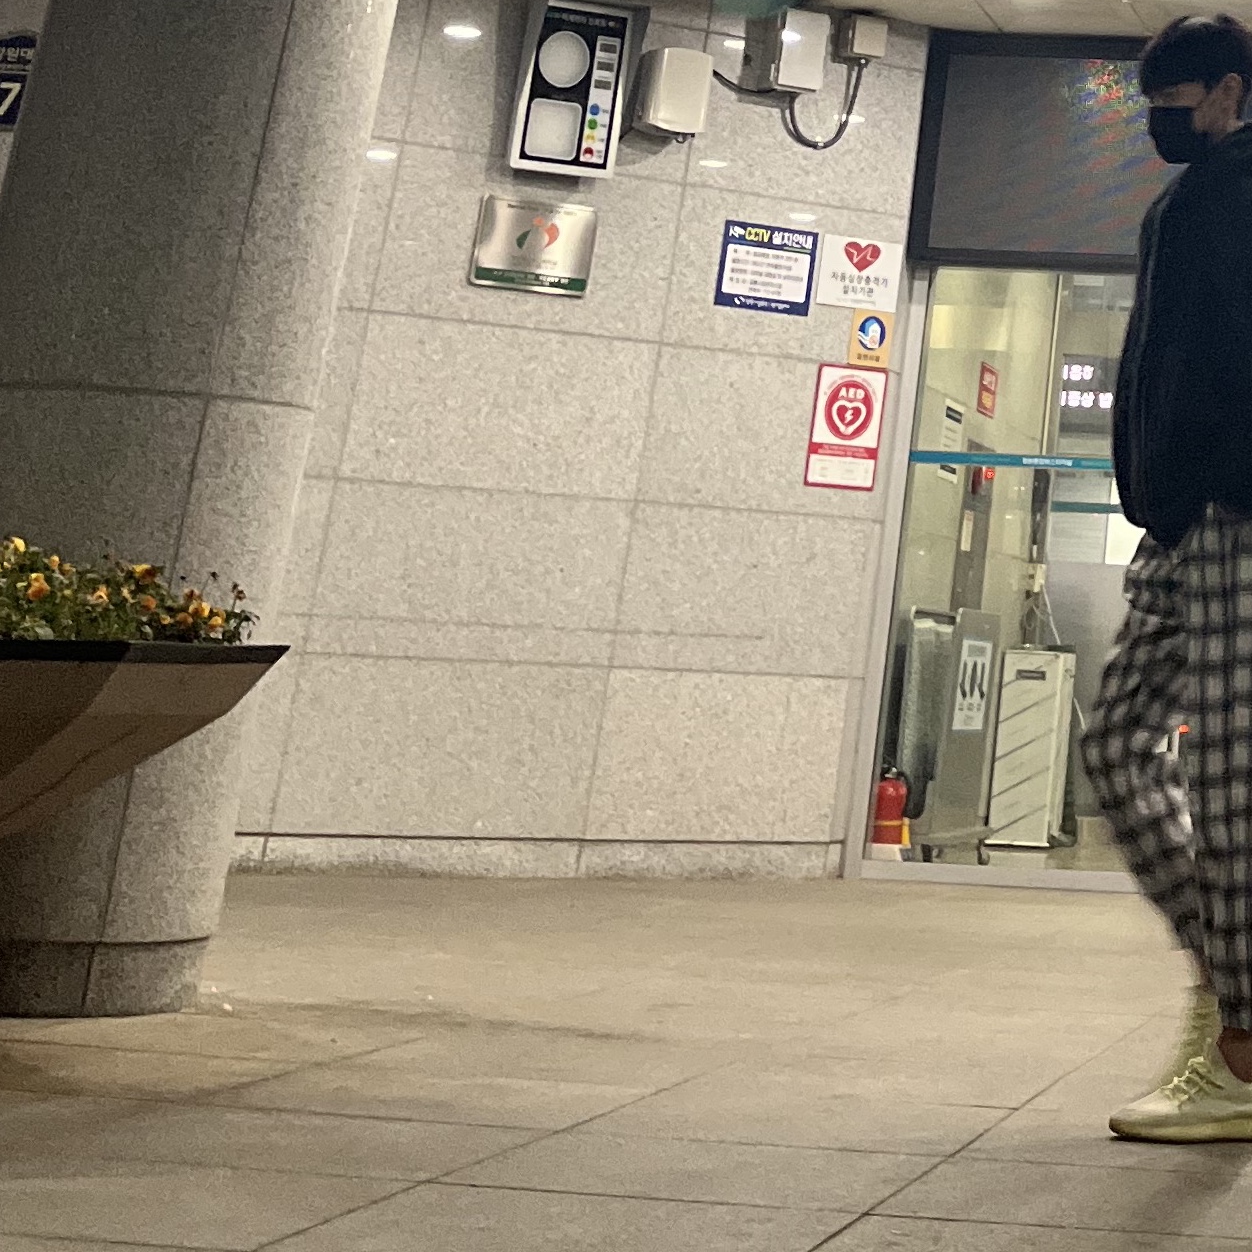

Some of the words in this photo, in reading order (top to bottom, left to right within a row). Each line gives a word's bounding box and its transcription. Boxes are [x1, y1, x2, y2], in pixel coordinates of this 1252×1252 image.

[745, 227, 771, 243] CCTV
[772, 230, 814, 249] 설치안내
[831, 271, 889, 288] 자동심장충격기
[843, 285, 874, 297] 설치기관
[838, 387, 866, 400] AED
